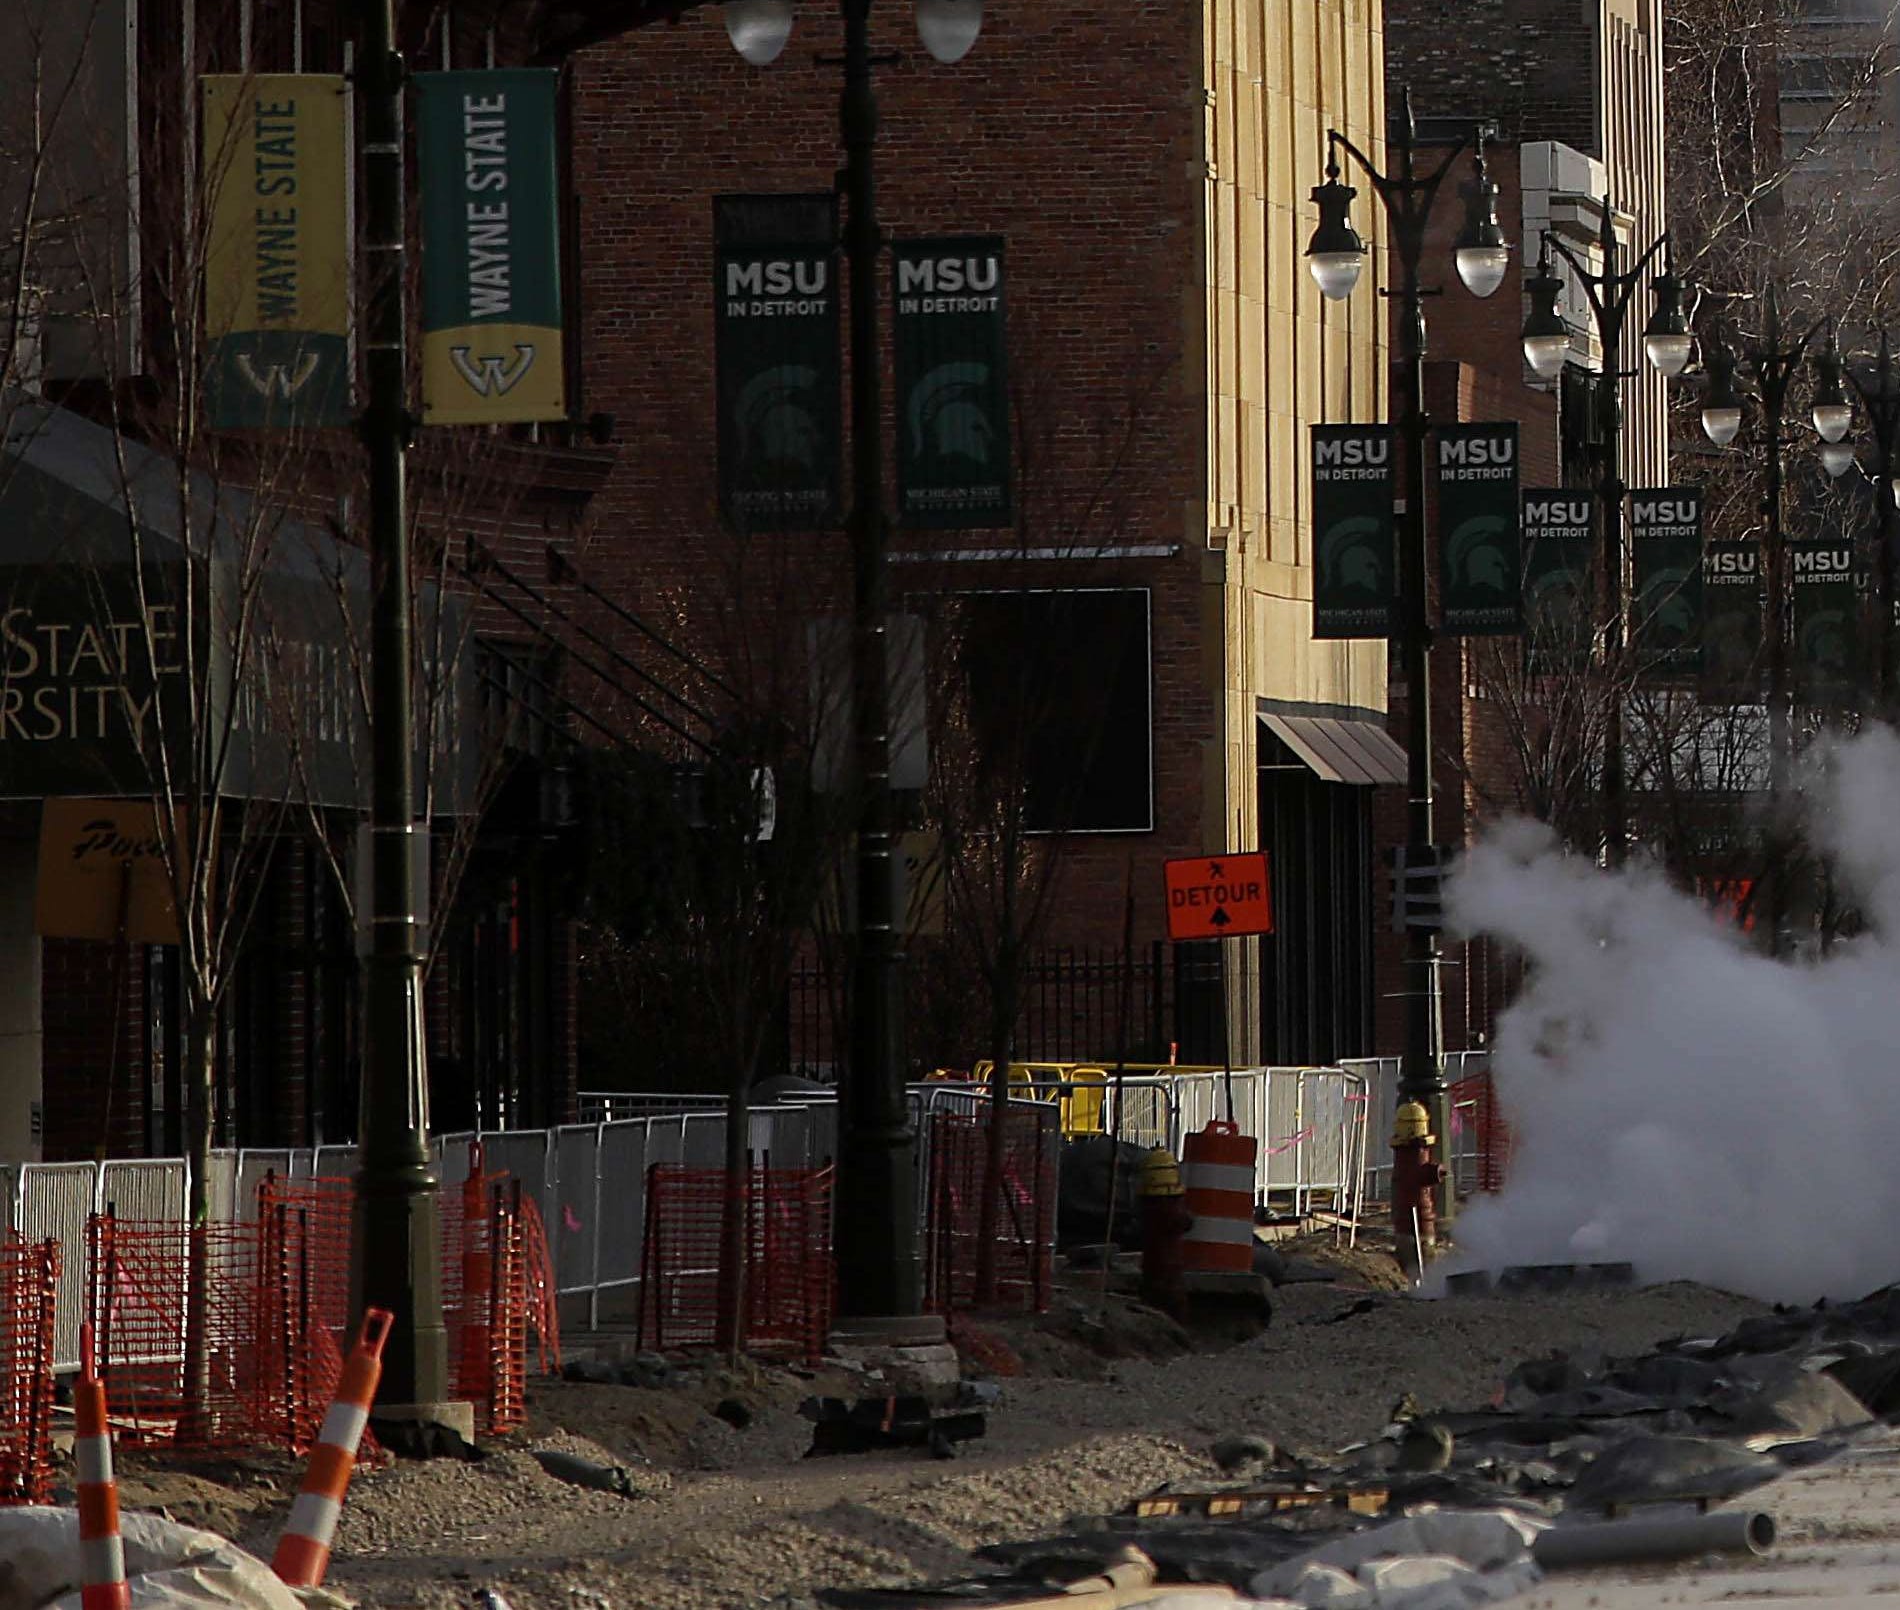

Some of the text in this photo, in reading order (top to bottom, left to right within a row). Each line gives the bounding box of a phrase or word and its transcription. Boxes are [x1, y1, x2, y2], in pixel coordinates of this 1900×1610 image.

[255, 99, 298, 322] WAYNE STATE
[463, 92, 512, 318] WAYNE STATE
[726, 259, 828, 296] MSU
[898, 257, 999, 293] MSU
[727, 297, 828, 317] IN DETROIT
[899, 296, 999, 314] IN DETROIT
[1315, 439, 1390, 466] MSU
[1439, 438, 1513, 465] MSU
[1315, 468, 1390, 481] IN DETROIT
[1440, 467, 1513, 481] IN DETROIT
[1525, 502, 1590, 526] MSU
[1634, 501, 1697, 524] MSU
[1525, 527, 1590, 539] IN DETROIT
[1634, 525, 1697, 538] IN DETROIT
[1702, 552, 1755, 573] MSU
[1793, 550, 1850, 572] MSU
[1713, 575, 1756, 585] DETROIT
[1795, 573, 1851, 584] IN DETROIT
[1, 605, 183, 679] STATE
[1171, 882, 1262, 909] DETOUR
